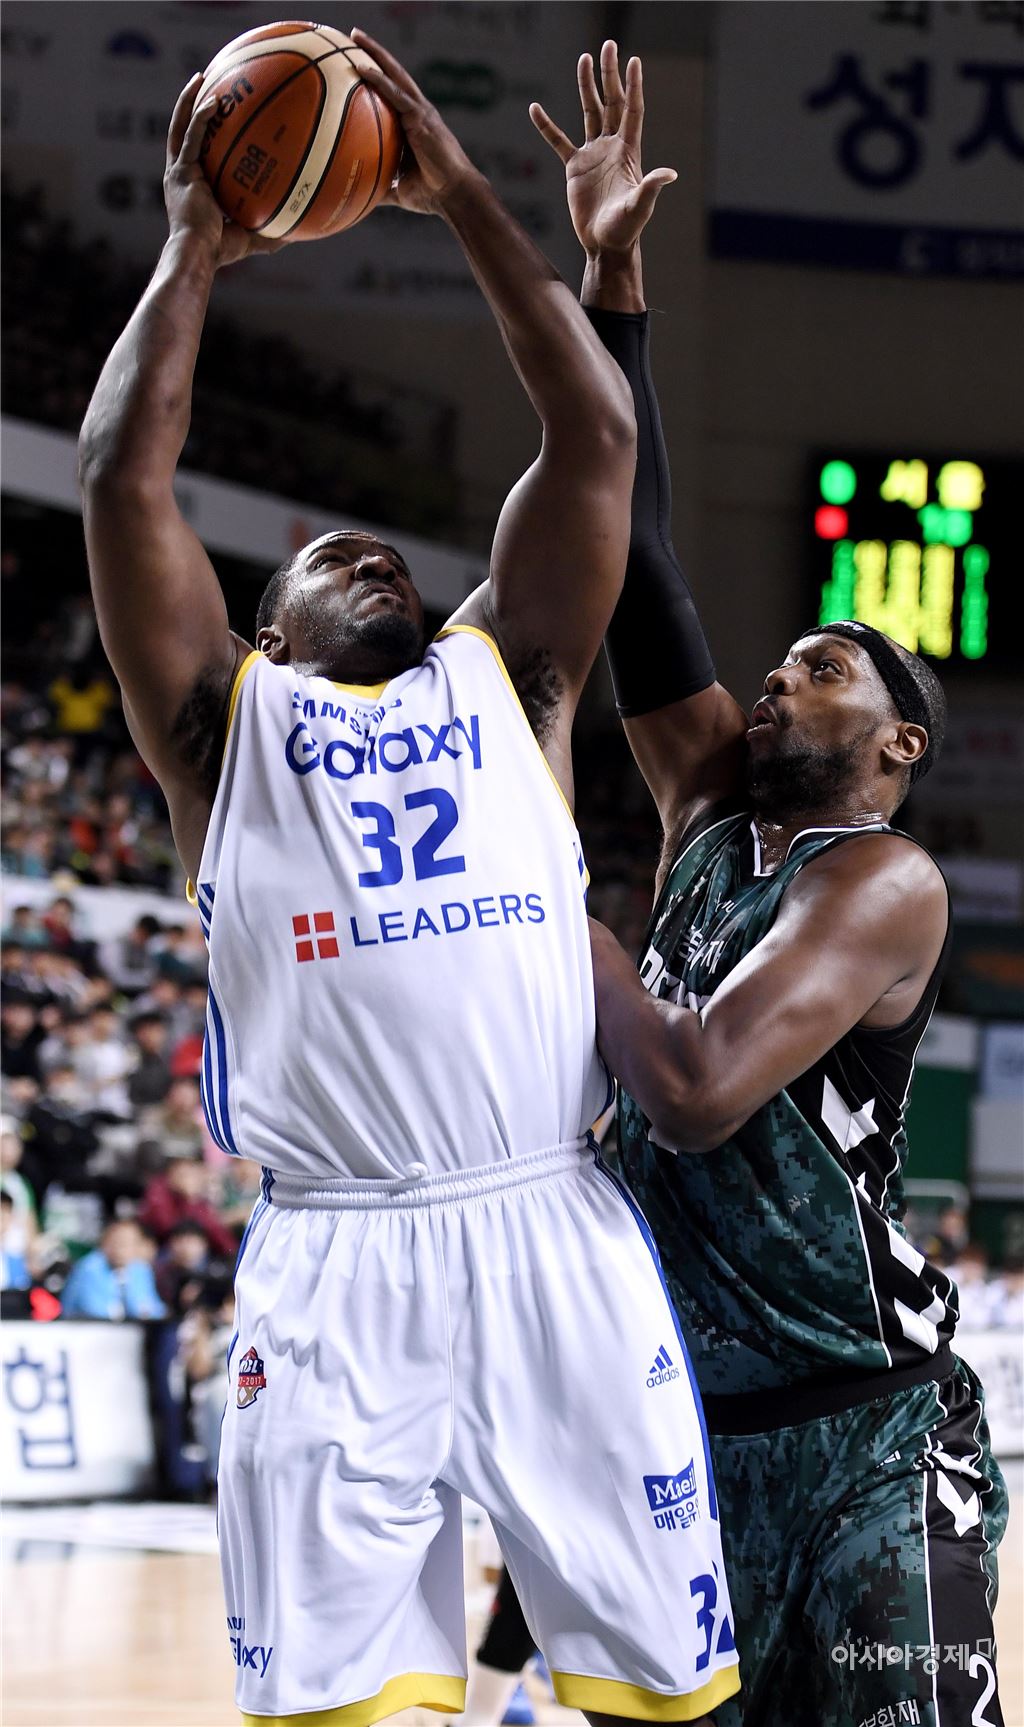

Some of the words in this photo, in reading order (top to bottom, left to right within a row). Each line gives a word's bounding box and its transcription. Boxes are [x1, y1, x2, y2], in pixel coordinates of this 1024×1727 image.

[233, 144, 267, 190] FIBA
[285, 715, 482, 780] Galaxy
[351, 788, 466, 888] 32
[350, 893, 546, 947] LEADERS
[646, 1367, 679, 1388] adidas
